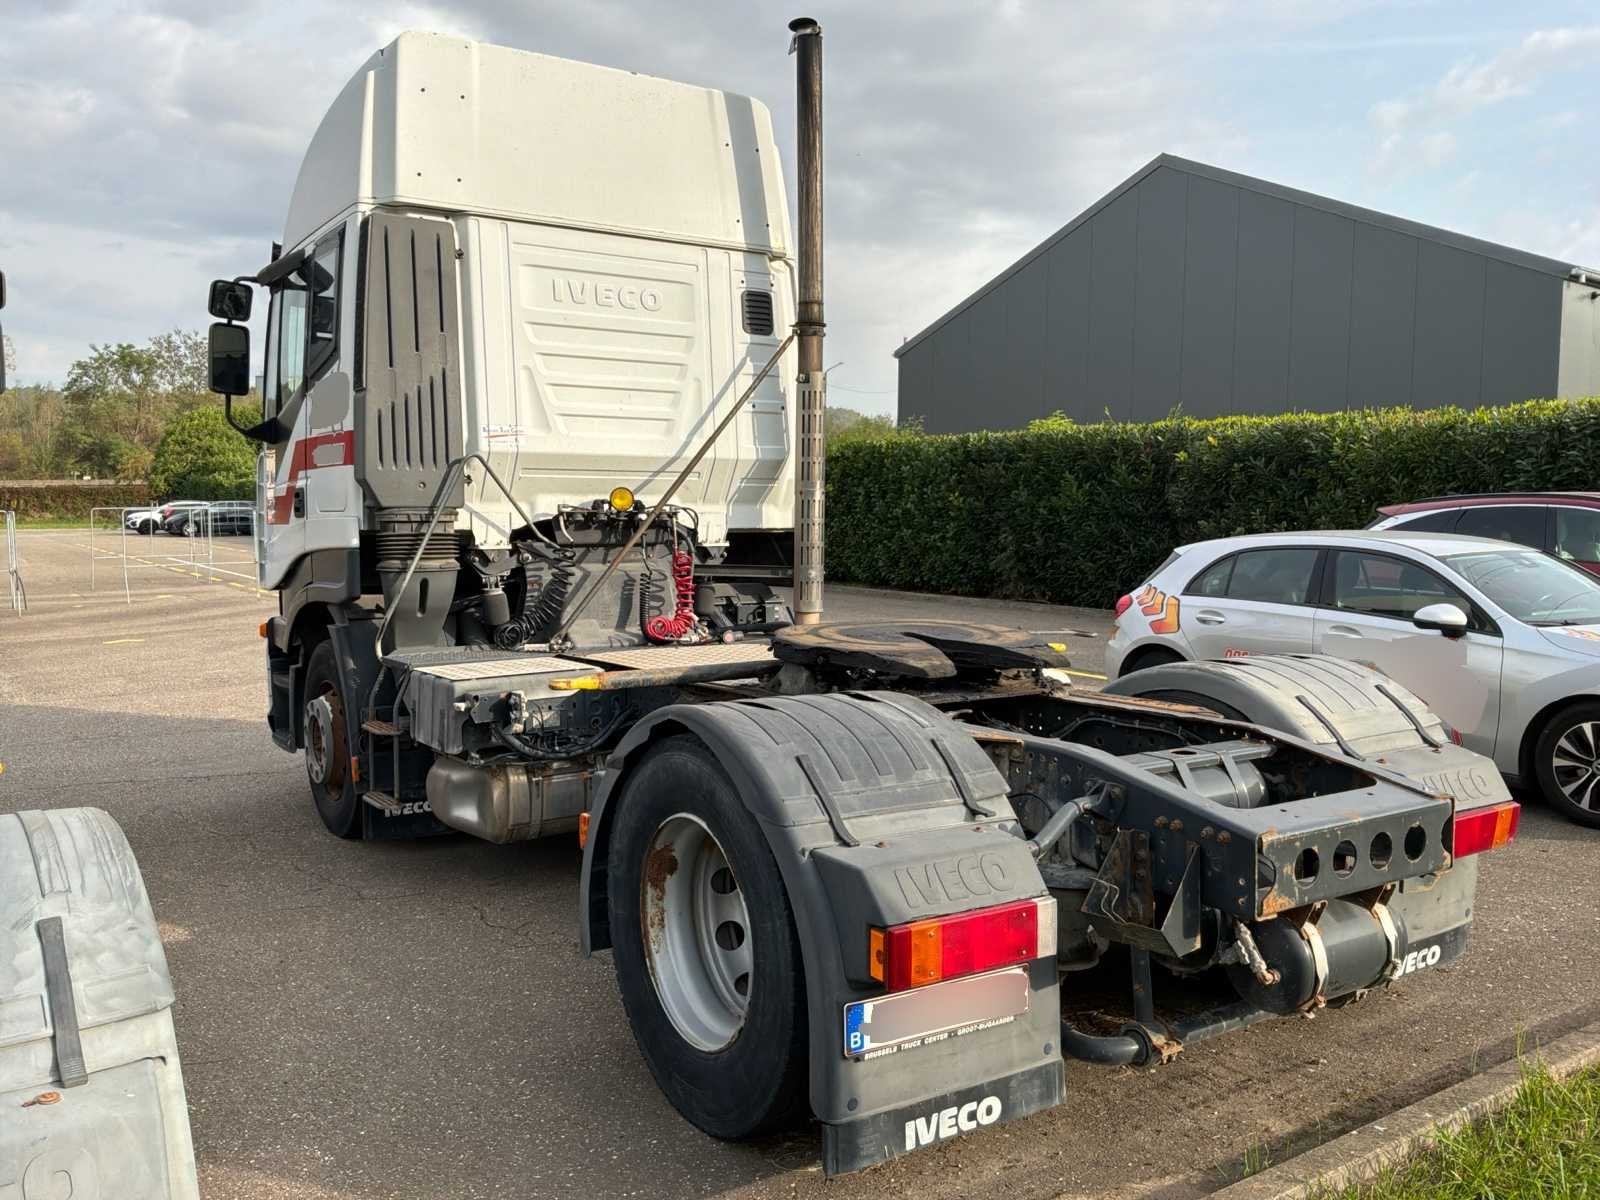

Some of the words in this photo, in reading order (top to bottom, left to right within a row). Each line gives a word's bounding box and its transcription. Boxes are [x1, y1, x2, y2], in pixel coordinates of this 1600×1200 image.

[553, 279, 662, 311] IVECO
[894, 852, 1014, 909] IVECO
[850, 1031, 862, 1049] B
[864, 1046, 898, 1061] BRUSSELS
[900, 1040, 922, 1052] TRUCK
[924, 1032, 949, 1045] CENTER
[904, 1095, 1002, 1151] IVECO
